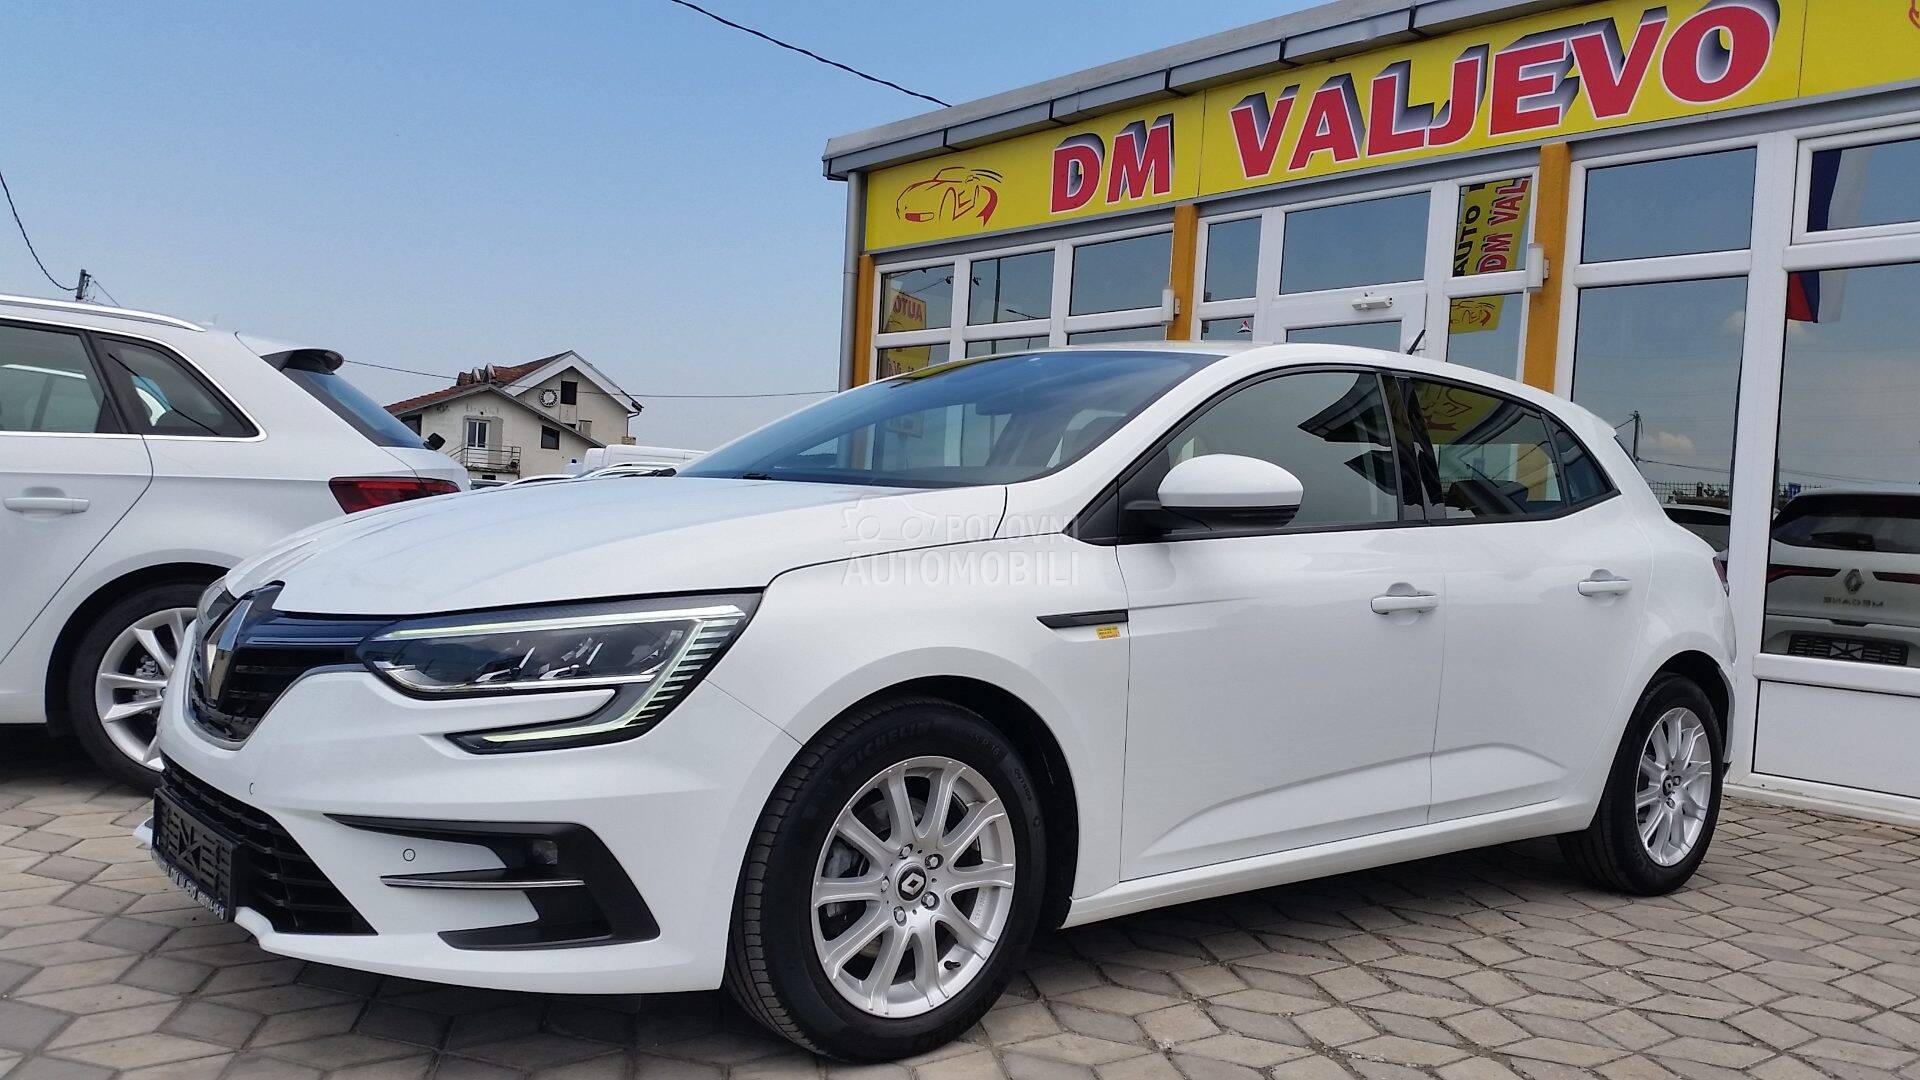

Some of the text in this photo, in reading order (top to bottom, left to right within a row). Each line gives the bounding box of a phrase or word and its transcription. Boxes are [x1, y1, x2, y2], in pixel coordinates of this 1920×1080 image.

[1049, 0, 1780, 214] DM VALJEVO
[1475, 233, 1513, 272] DM
